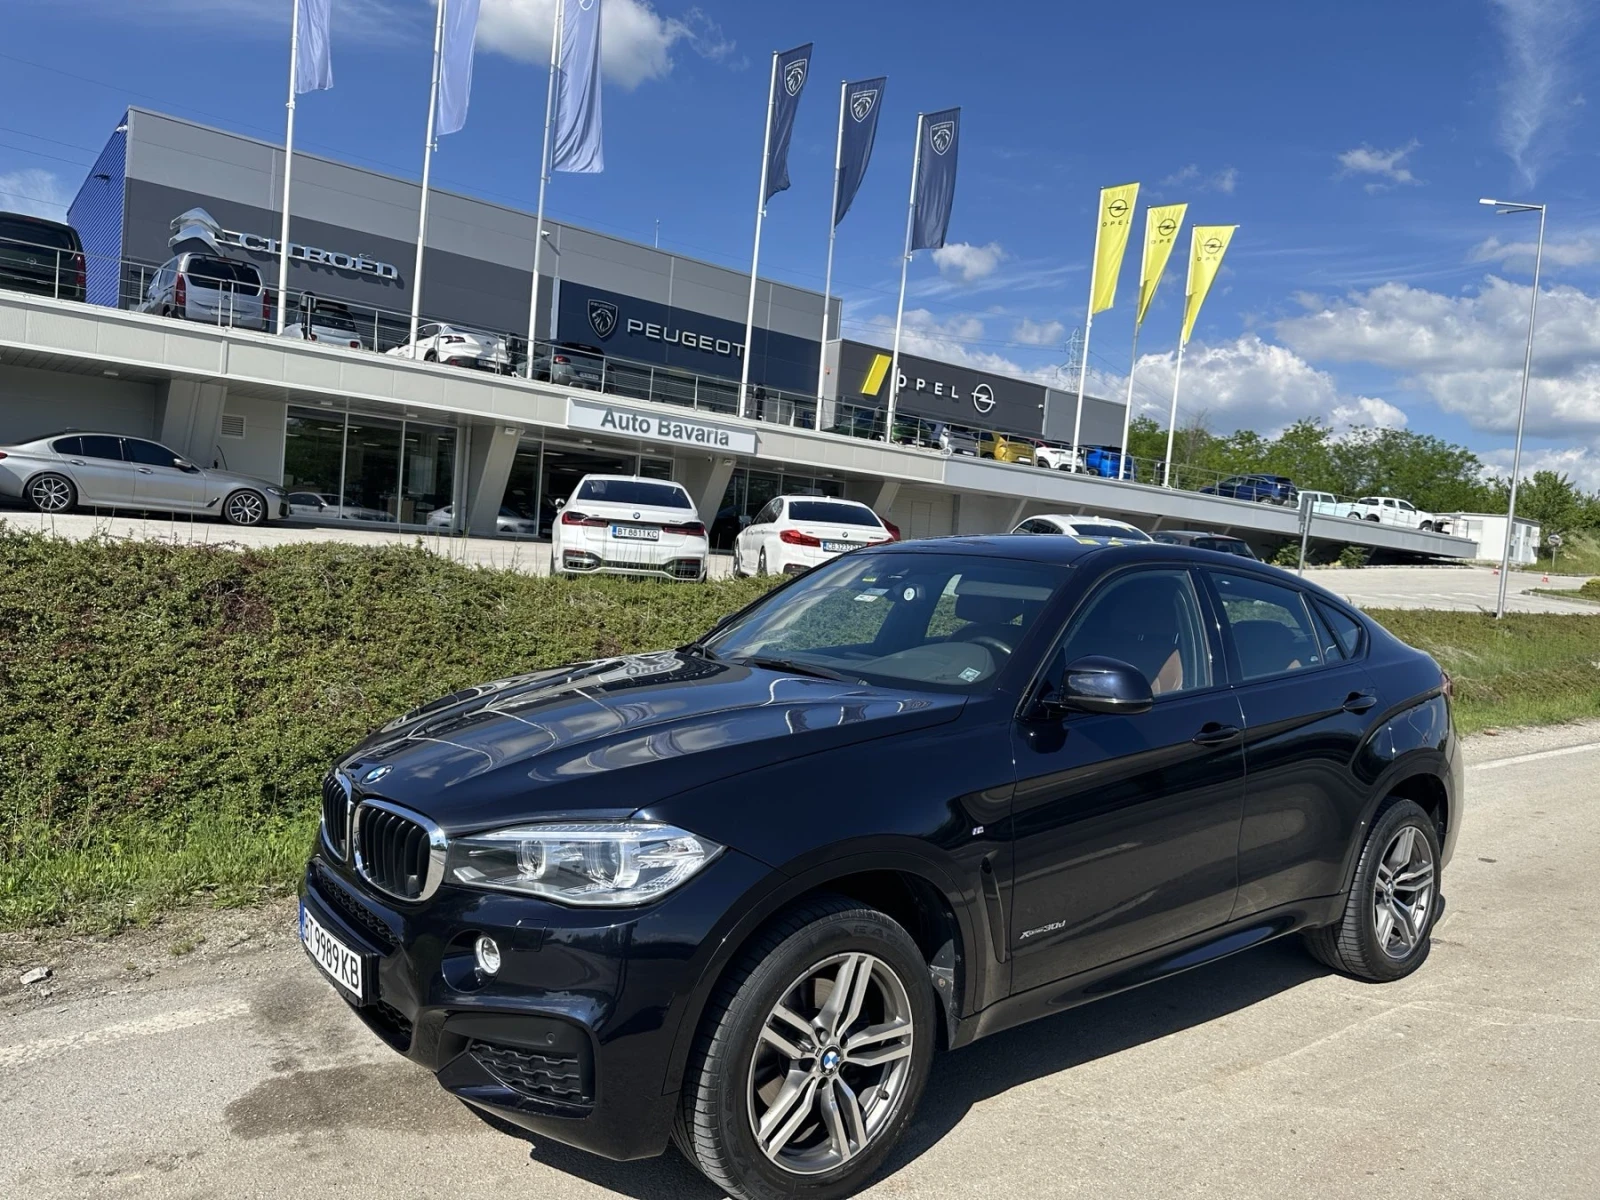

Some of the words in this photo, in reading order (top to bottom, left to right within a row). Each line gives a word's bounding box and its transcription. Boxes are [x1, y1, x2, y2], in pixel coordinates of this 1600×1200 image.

[627, 318, 747, 357] PEUGEOT
[897, 374, 959, 398] OPEL
[600, 408, 650, 433] Auto
[658, 417, 729, 446] Bavaria
